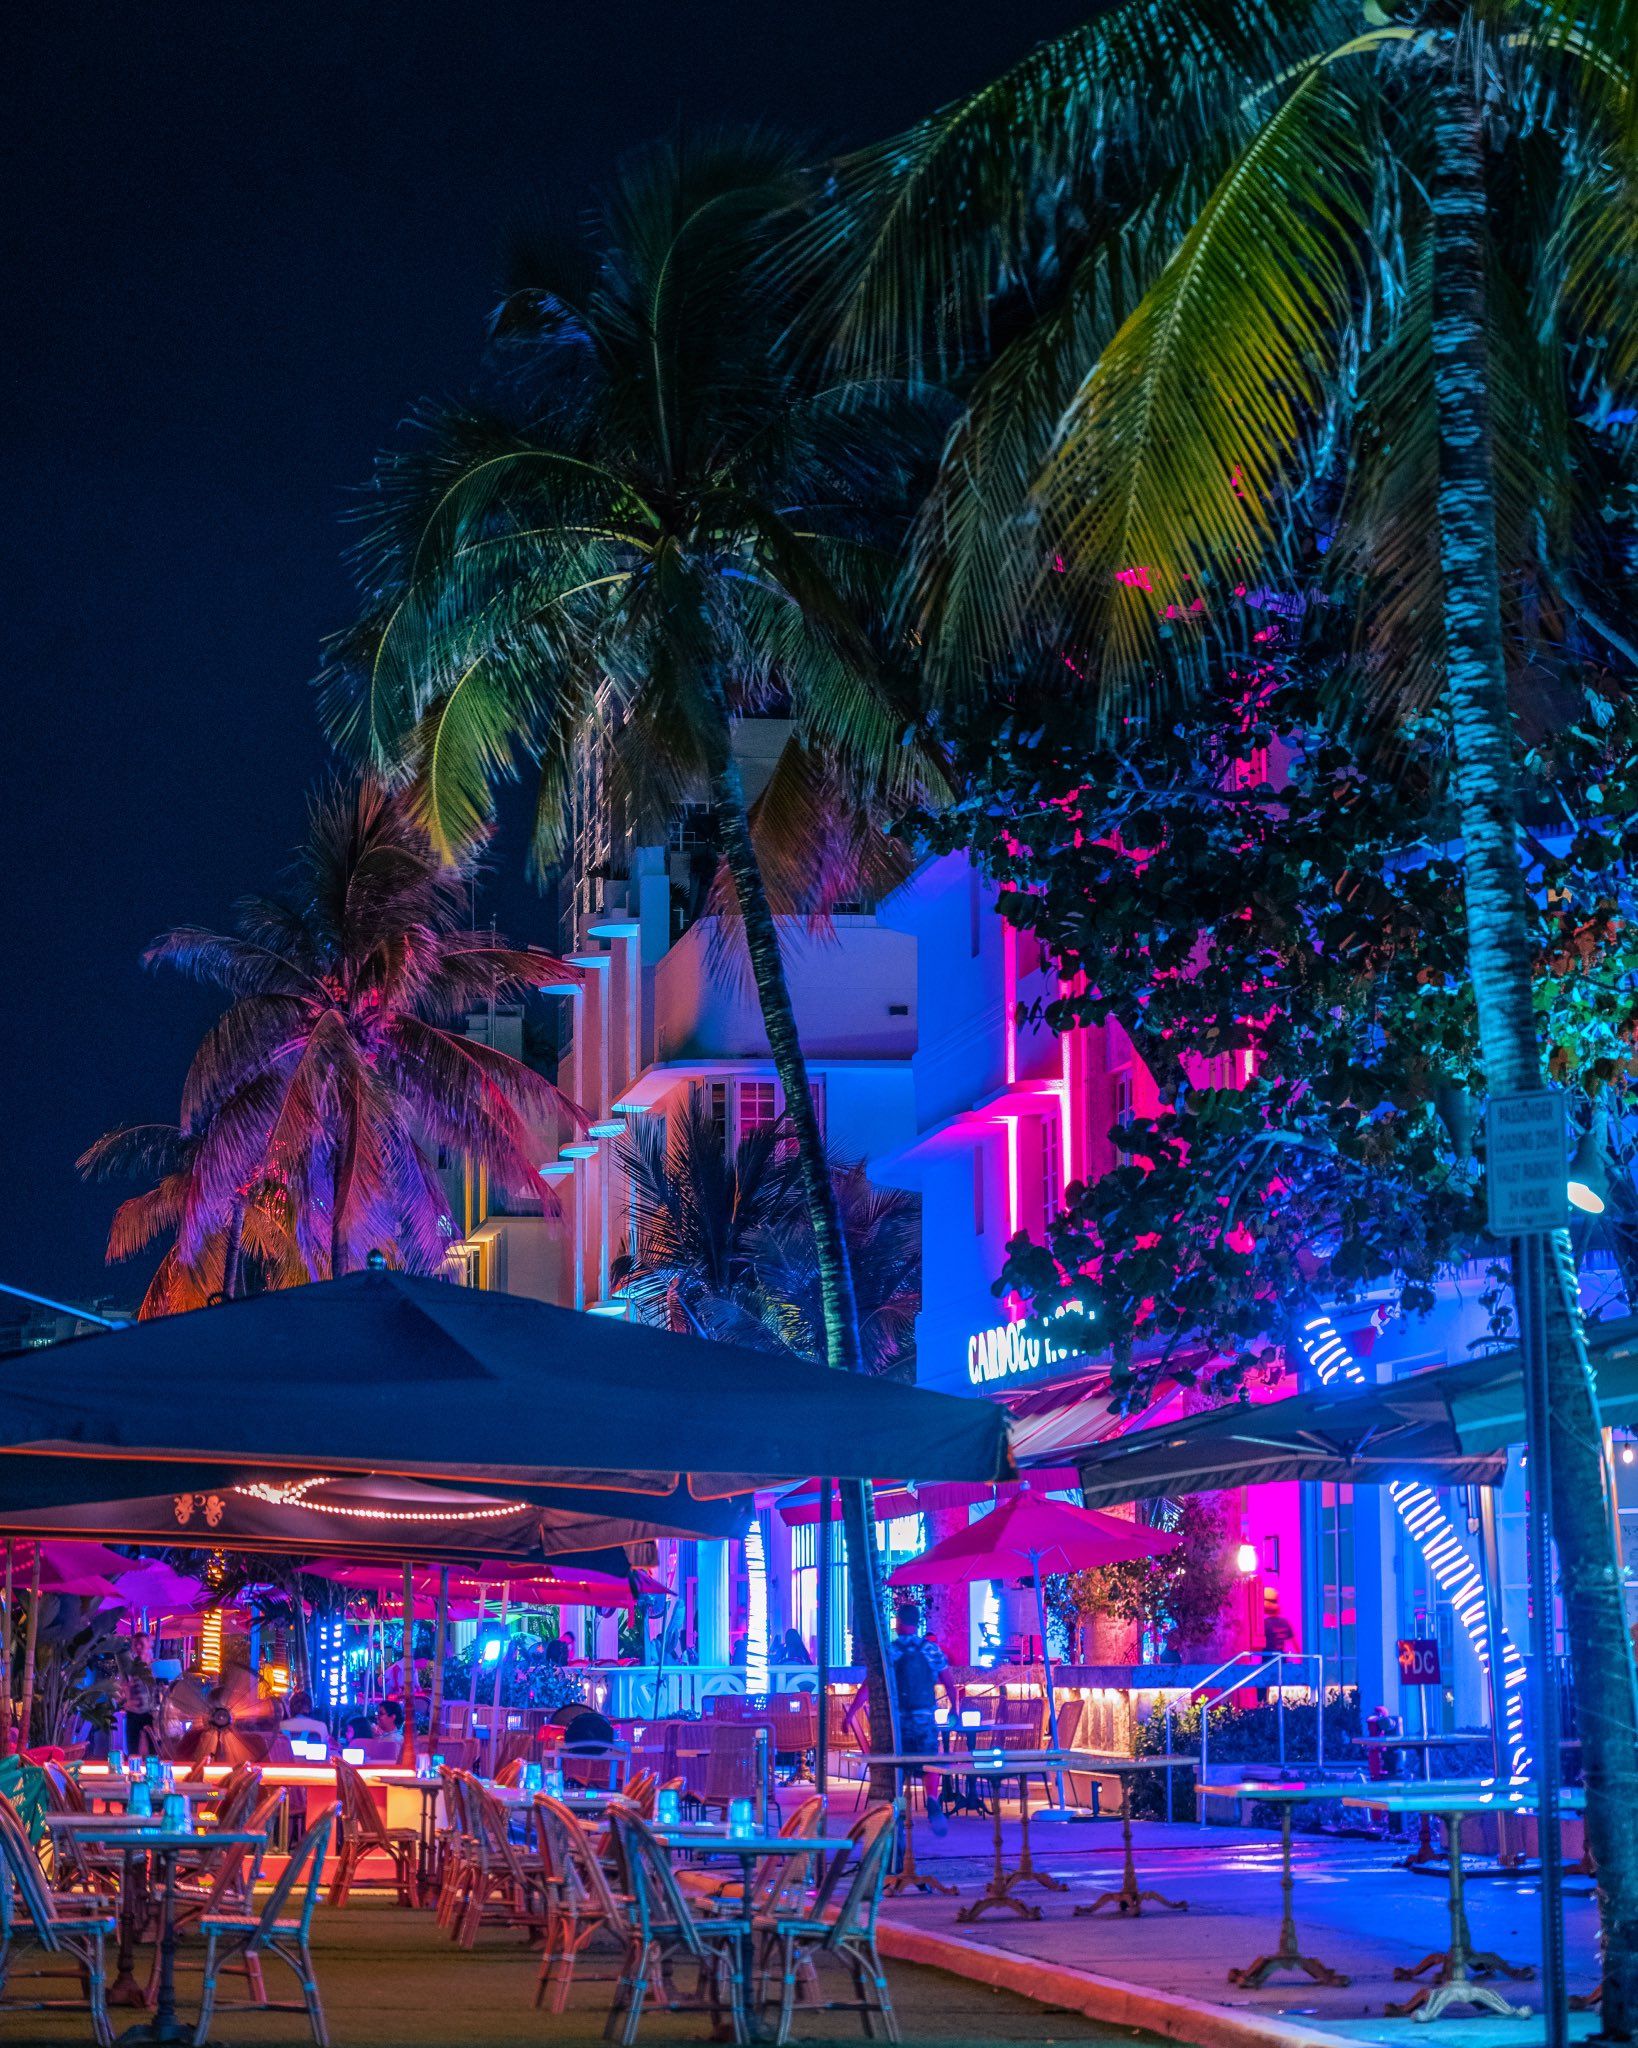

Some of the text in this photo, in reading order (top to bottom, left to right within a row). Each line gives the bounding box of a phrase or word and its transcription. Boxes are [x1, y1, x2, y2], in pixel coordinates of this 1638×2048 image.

[1499, 1102, 1553, 1123] PASSENGER
[1494, 1128, 1559, 1152] LOADING ZONE
